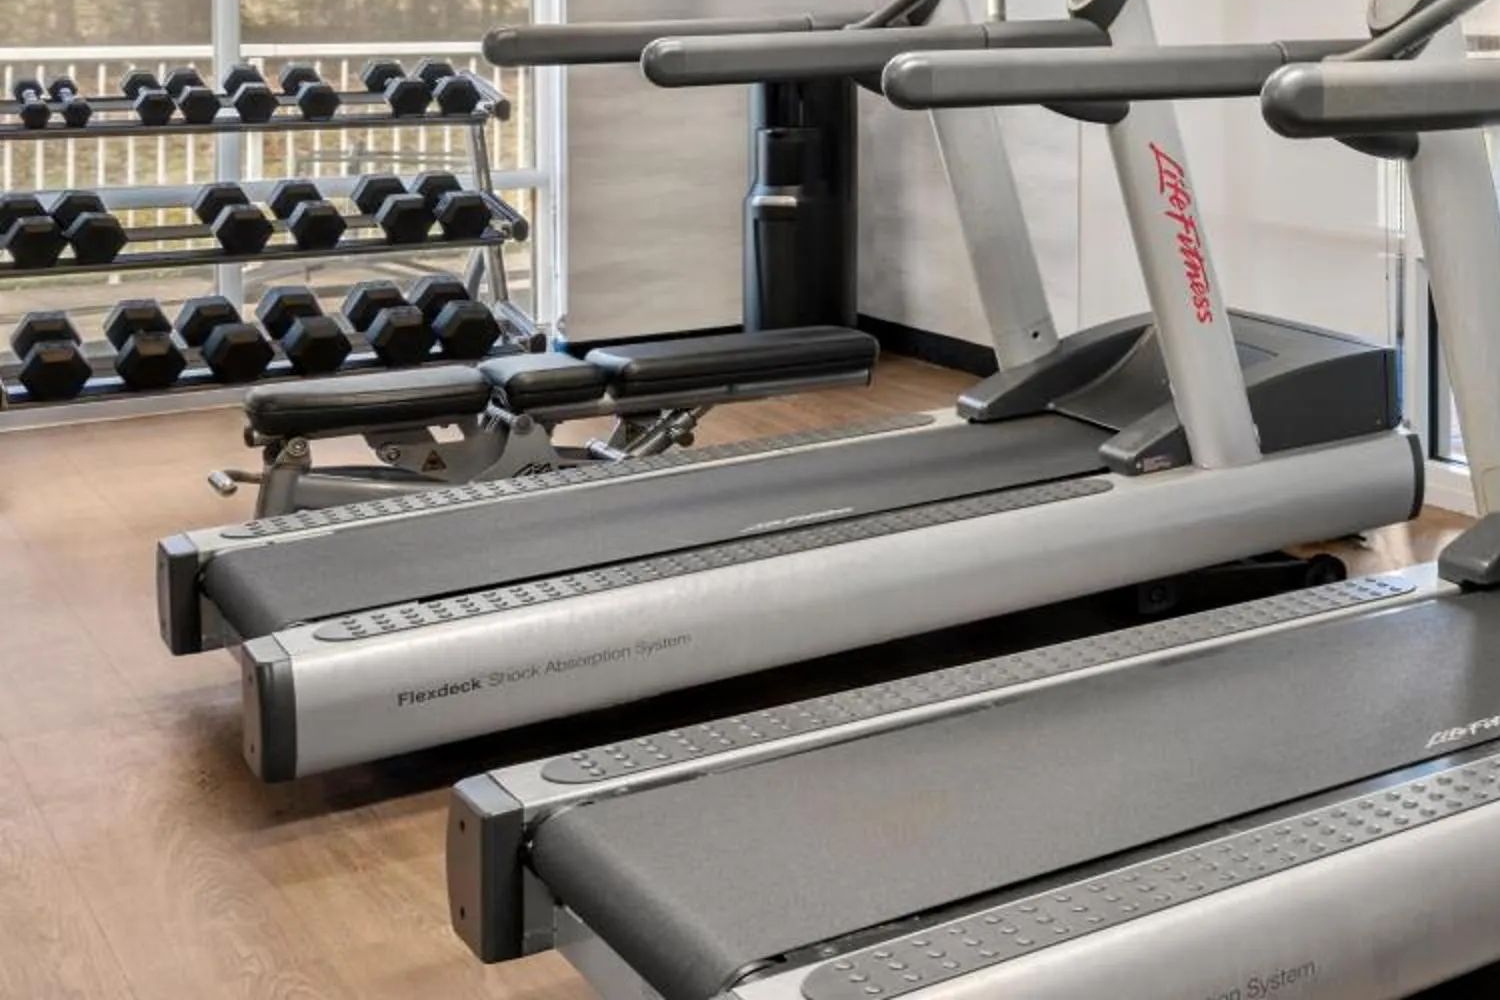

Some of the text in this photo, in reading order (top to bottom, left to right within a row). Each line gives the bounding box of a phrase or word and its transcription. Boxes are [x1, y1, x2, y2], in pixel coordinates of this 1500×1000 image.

[396, 633, 694, 707] Flexdeck Shock Absorption System
[1246, 960, 1316, 1000] System
